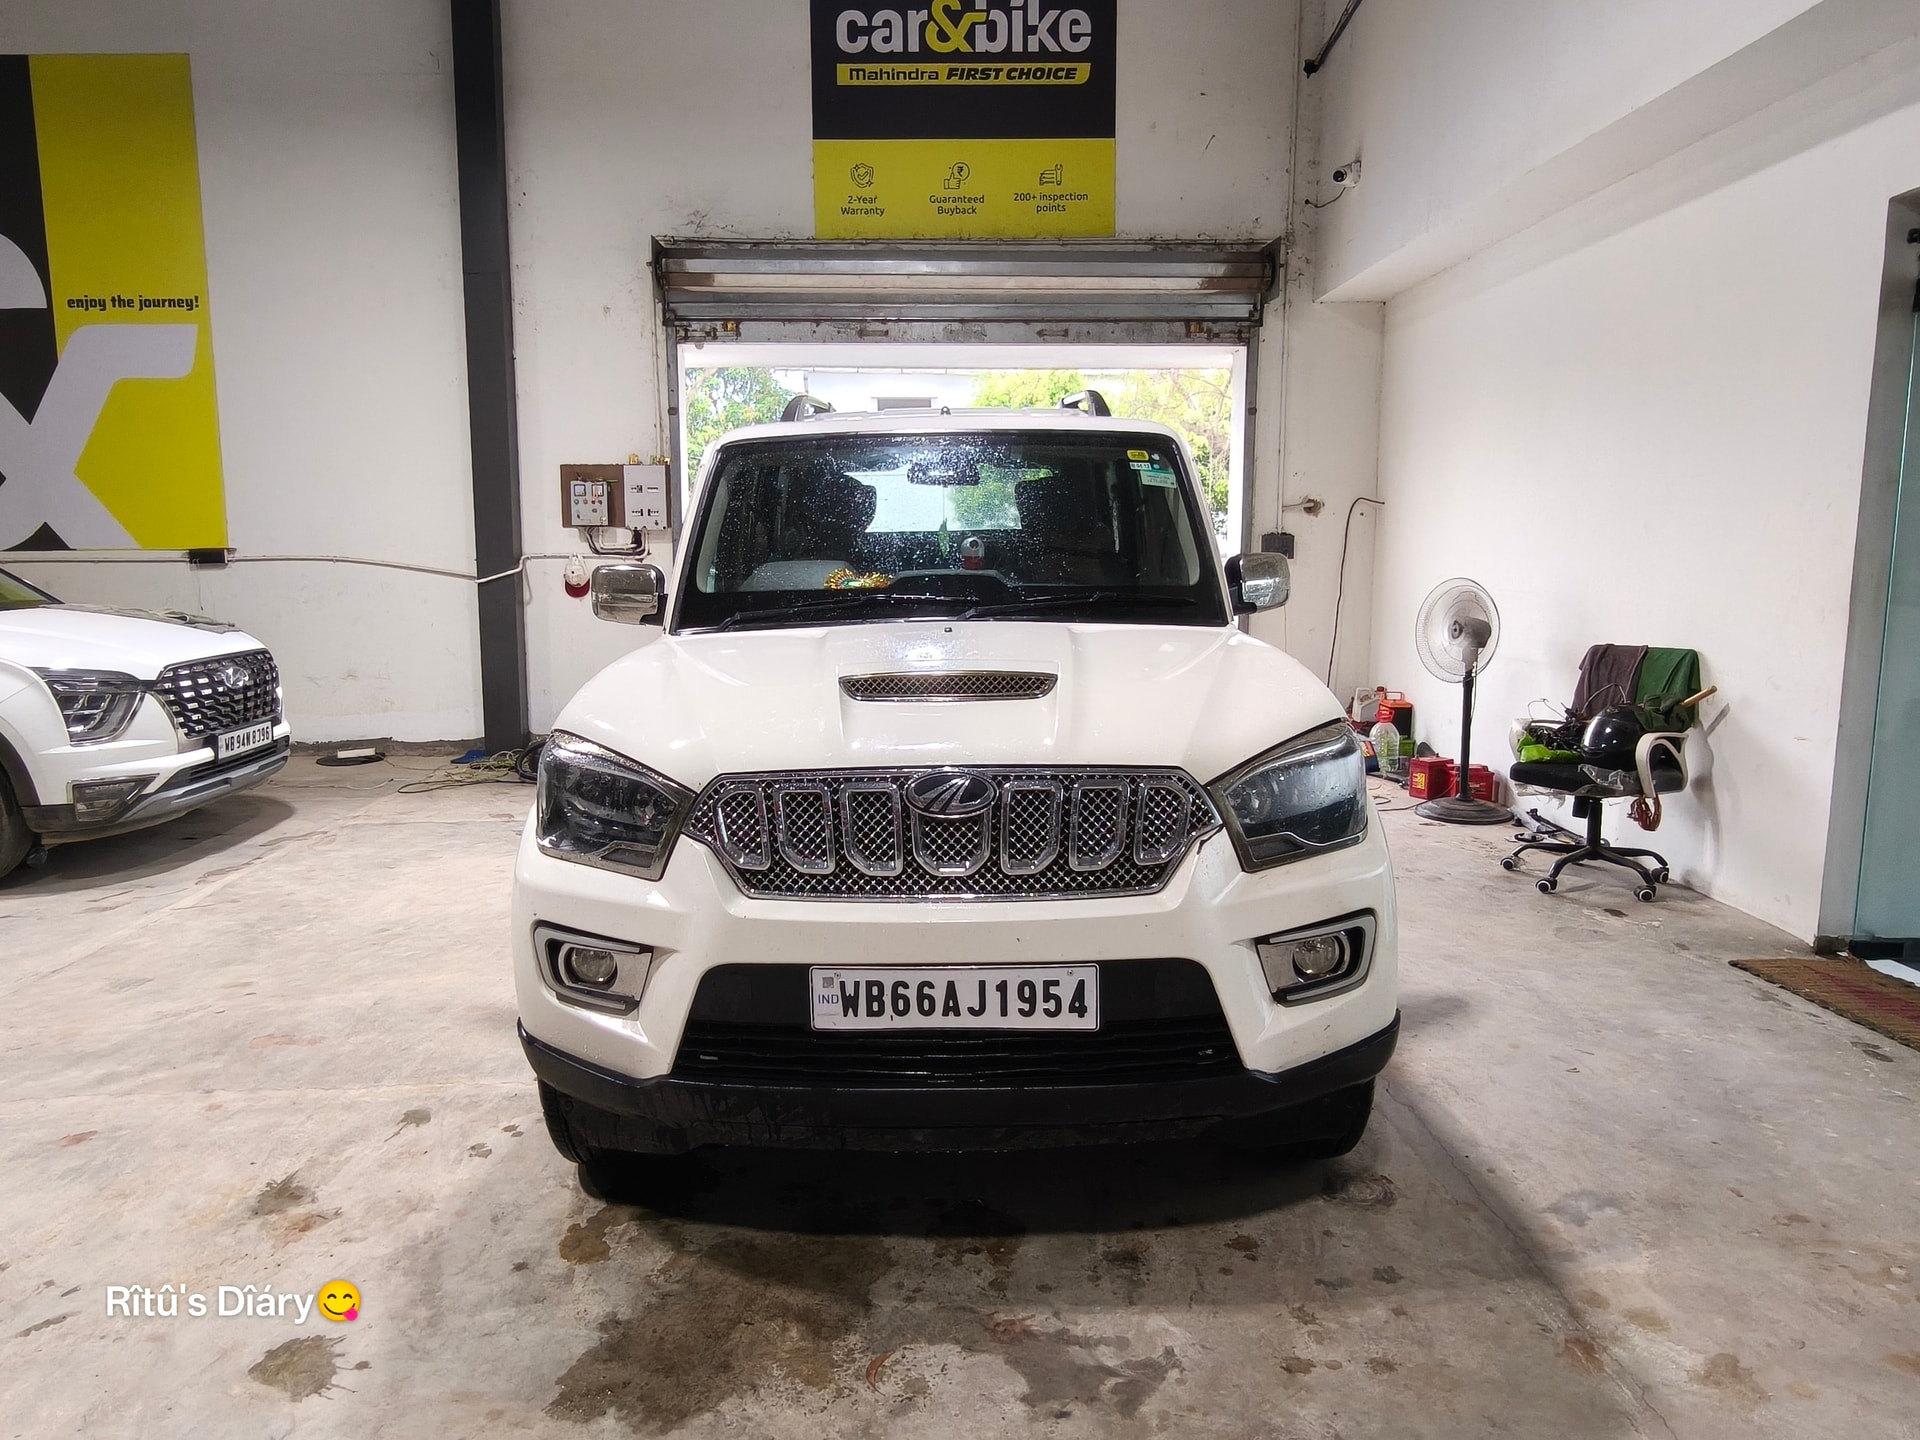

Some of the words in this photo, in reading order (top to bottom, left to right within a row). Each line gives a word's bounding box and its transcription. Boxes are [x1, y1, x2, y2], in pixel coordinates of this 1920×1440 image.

[836, 0, 1092, 53] car&bike
[849, 67, 939, 81] Mahindra
[946, 67, 1004, 81] FIRST
[1005, 67, 1078, 81] CHOICE
[847, 195, 878, 204] 2-Year
[929, 195, 985, 204] Guaranteed
[1013, 193, 1038, 202] 200+
[1039, 192, 1089, 203] inspection
[840, 206, 885, 216] Warranty
[937, 206, 977, 216] Buyback
[1036, 203, 1066, 214] points
[67, 294, 107, 311] enjoy
[110, 294, 135, 308] the
[138, 294, 199, 311] journey!
[818, 994, 839, 1005] IND
[839, 979, 1088, 1018] WB66AJ1954
